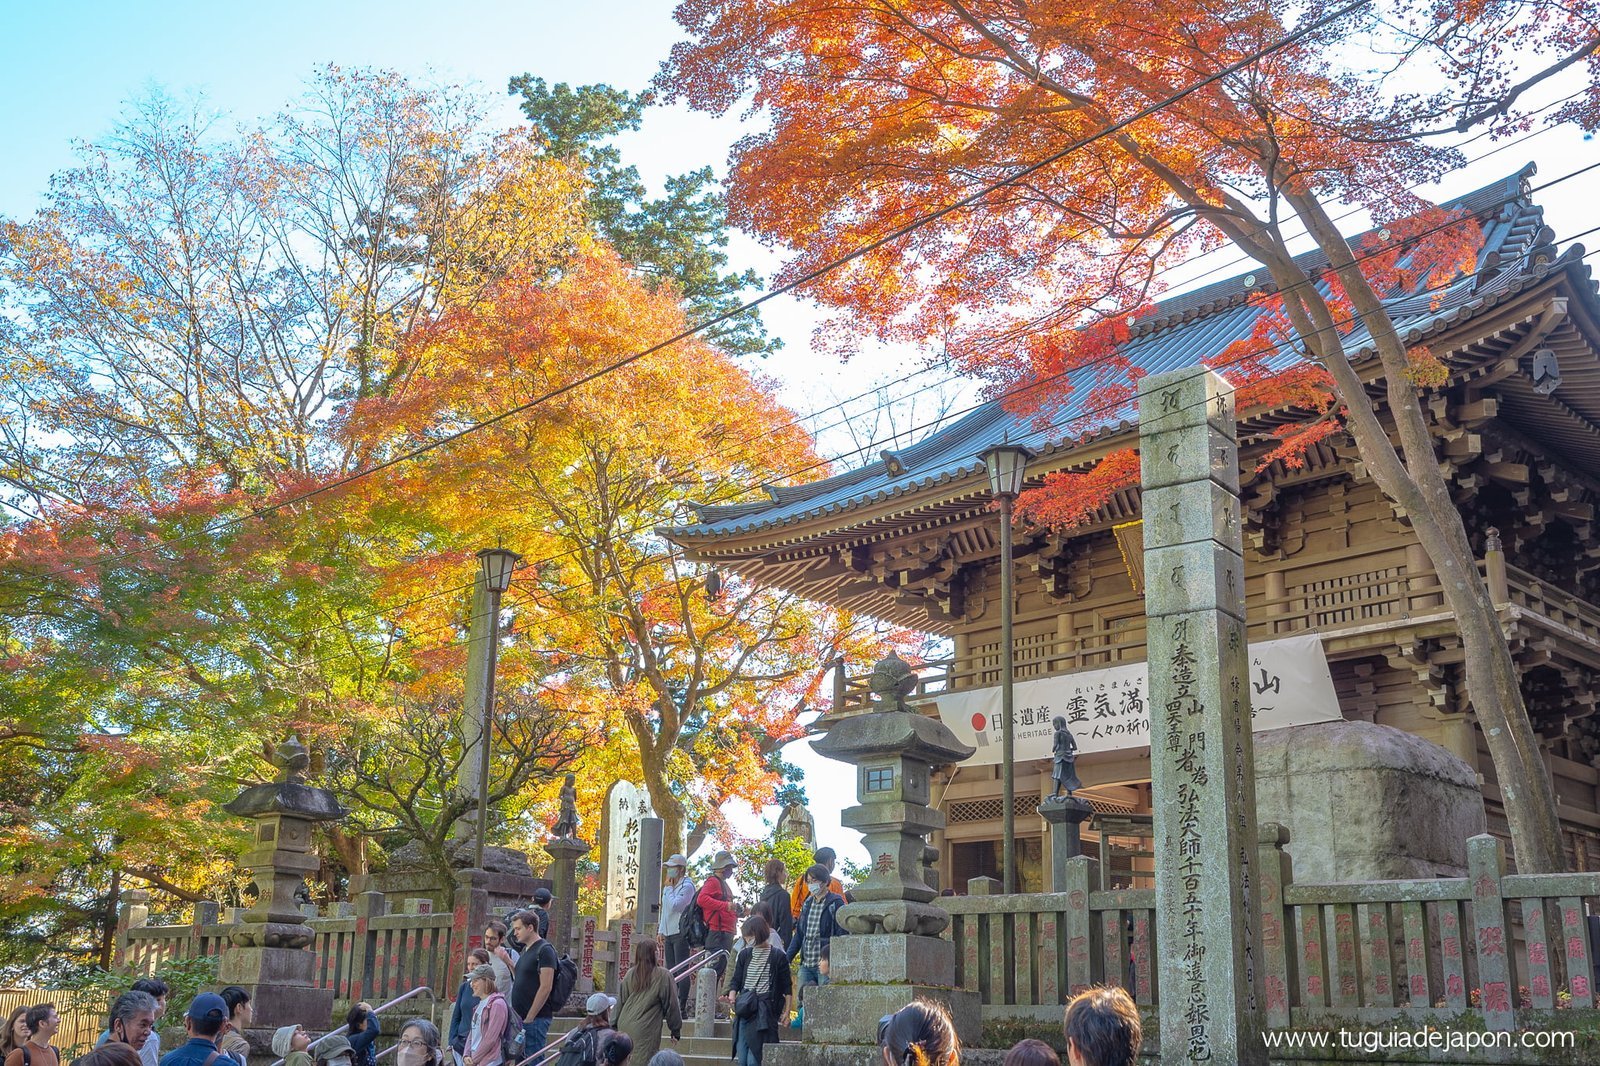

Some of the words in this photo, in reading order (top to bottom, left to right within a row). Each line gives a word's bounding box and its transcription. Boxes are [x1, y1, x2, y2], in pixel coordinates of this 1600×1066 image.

[1065, 687, 1150, 726] 霊気満
[1252, 668, 1280, 695] 山
[1017, 728, 1052, 740] HERITAGE
[874, 852, 896, 876] 奉
[582, 919, 596, 978] 埼玉県連
